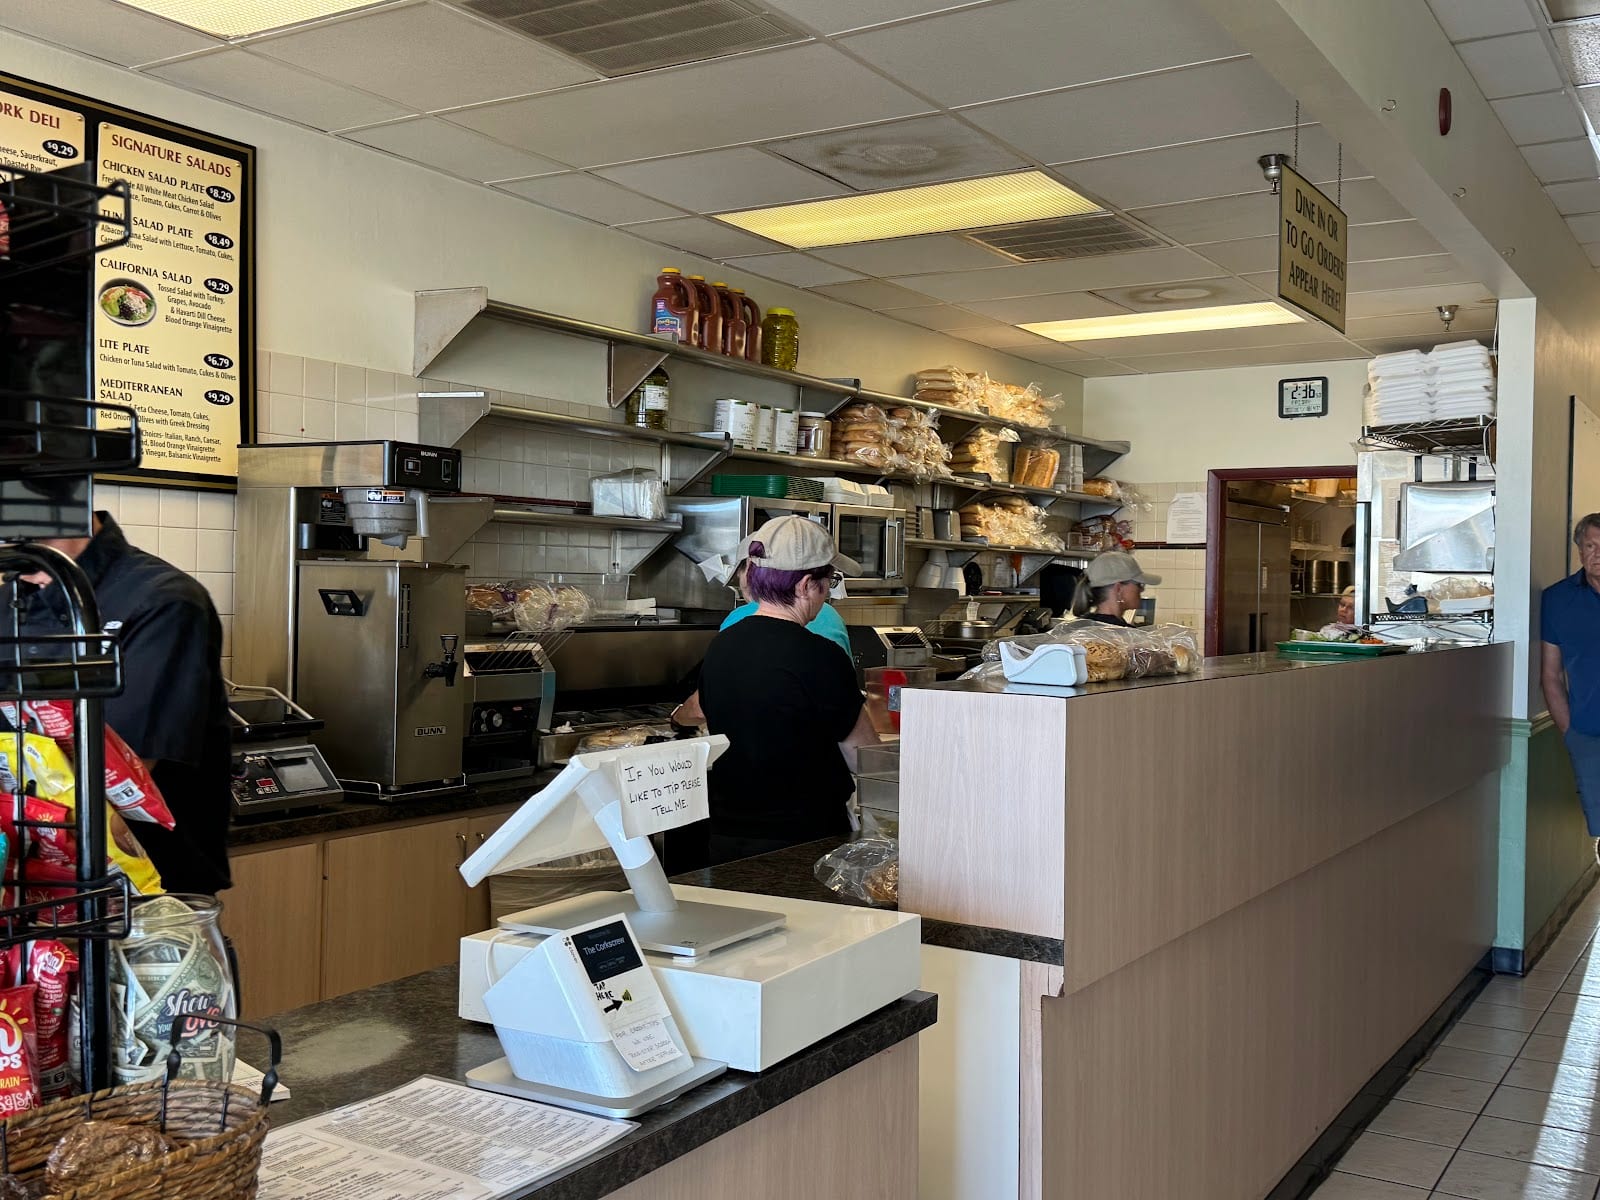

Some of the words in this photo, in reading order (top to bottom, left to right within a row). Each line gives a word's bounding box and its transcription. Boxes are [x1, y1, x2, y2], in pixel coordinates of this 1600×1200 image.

[0, 102, 23, 119] RK
[29, 110, 61, 129] DELI
[0, 146, 19, 158] eese,
[20, 150, 58, 167] Sauerkraut,
[47, 141, 74, 157] $9.29
[111, 134, 182, 164] SIGNATURE
[186, 155, 231, 178] SALADS
[4, 157, 29, 170] Toasted
[102, 159, 145, 178] CHICKEN
[148, 171, 177, 187] SALAD
[180, 179, 205, 194] PLATE
[136, 182, 144, 191] All
[145, 184, 162, 196] White
[162, 189, 177, 200] Meat
[178, 193, 199, 206] Chicken
[199, 199, 215, 210] Salad
[209, 187, 232, 201] $8.29
[141, 194, 163, 207] Tomato,
[164, 200, 182, 213] Cukes,
[182, 205, 200, 216] Carrot
[200, 209, 205, 217] &
[205, 210, 222, 222] Olives
[1295, 187, 1315, 224] DINE
[1317, 205, 1326, 232] IN
[1327, 213, 1338, 242] OR
[133, 216, 164, 232] SALAD
[167, 224, 193, 239] PLATE
[101, 224, 124, 235] Albacor
[142, 234, 159, 244] Salad
[159, 237, 172, 247] with
[172, 239, 195, 253] Lettuce,
[195, 245, 217, 258] Tomato,
[126, 241, 143, 251] Olives
[208, 234, 230, 248] $8.49
[1285, 219, 1298, 249] TO
[1300, 230, 1315, 260] GO
[1317, 241, 1344, 282] ORDERS
[100, 257, 159, 278] CALIFORNIA
[162, 270, 193, 285] SALAD
[157, 283, 176, 294] Tossed
[176, 287, 193, 297] Salad
[193, 291, 206, 300] with
[206, 292, 226, 305] Turkey,
[207, 279, 230, 293] $9.29
[1288, 260, 1319, 300] APPEAR
[1321, 280, 1341, 314] HERE!
[167, 295, 188, 307] Grapes,
[188, 299, 212, 310] Avocado
[170, 306, 175, 314] &
[175, 308, 196, 318] Havarti
[197, 311, 206, 320] Dill
[207, 313, 226, 323] Cheese
[165, 315, 182, 325] Blood
[182, 318, 202, 329] Orange
[202, 321, 233, 334] Vinaigrette
[99, 338, 118, 350] LITE
[122, 342, 150, 355] PLATE
[99, 353, 123, 364] Chicken
[123, 358, 130, 366] or
[130, 358, 145, 367] Tuna
[146, 360, 162, 370] Salad
[162, 364, 176, 372] with
[176, 365, 198, 376] Tomato,
[198, 368, 215, 378] Cukes
[220, 372, 237, 381] Olives
[207, 355, 230, 368] $6.79
[100, 377, 183, 397] MEDITERRANEAN
[100, 389, 133, 402] SALAD
[1291, 382, 1315, 400] 2:36
[207, 392, 231, 404] $9.29
[100, 410, 112, 419] Red
[137, 415, 155, 424] Olives
[155, 417, 169, 425] with
[169, 418, 186, 427] Greek
[186, 420, 210, 432] Dressing
[147, 406, 169, 416] Cheese,
[170, 408, 192, 419] Tomato,
[150, 437, 166, 447] Blood
[166, 440, 186, 450] Orange
[186, 443, 216, 454] Vinaigrette
[164, 431, 184, 442] Italian,
[184, 434, 203, 444] Ranch,
[203, 436, 222, 446] Caesar,
[145, 448, 168, 458] Vinegar,
[168, 450, 192, 460] Balsamic
[192, 452, 222, 463] Vinaigrette
[420, 450, 438, 458] BUNN
[417, 727, 443, 735] BUNN
[648, 763, 665, 777] YOU
[668, 759, 693, 774] WOULD
[629, 790, 649, 804] LIKE
[650, 788, 662, 799] TO
[680, 776, 702, 791] PLEASE
[651, 804, 674, 817] TELL
[674, 798, 689, 812] ME.
[583, 946, 597, 956] The
[595, 936, 626, 952] Corkscrew
[593, 981, 606, 991] TAP
[595, 990, 615, 1001] HERE
